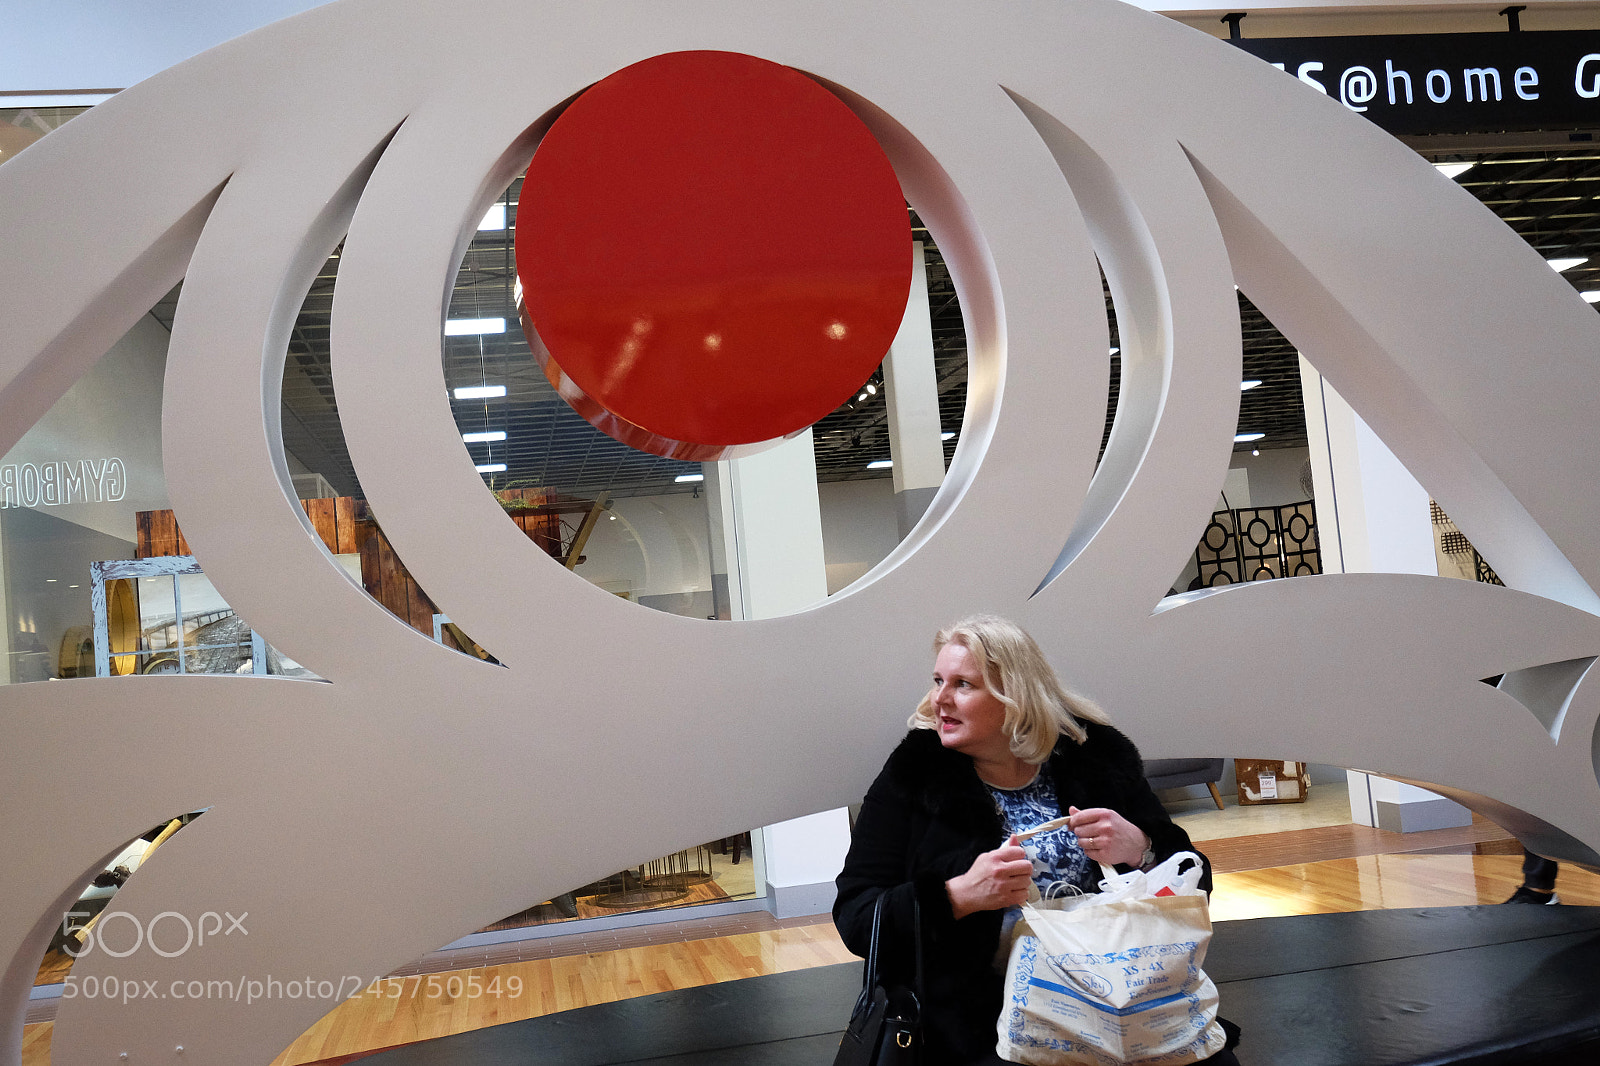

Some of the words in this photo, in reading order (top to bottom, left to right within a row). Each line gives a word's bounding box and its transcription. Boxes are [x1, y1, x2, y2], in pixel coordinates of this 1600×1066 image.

[1270, 59, 1540, 112] S@home
[1122, 965, 1139, 976] XS
[1149, 961, 1165, 971] 4X
[1126, 979, 1144, 988] Fair
[1147, 975, 1169, 985] Trade
